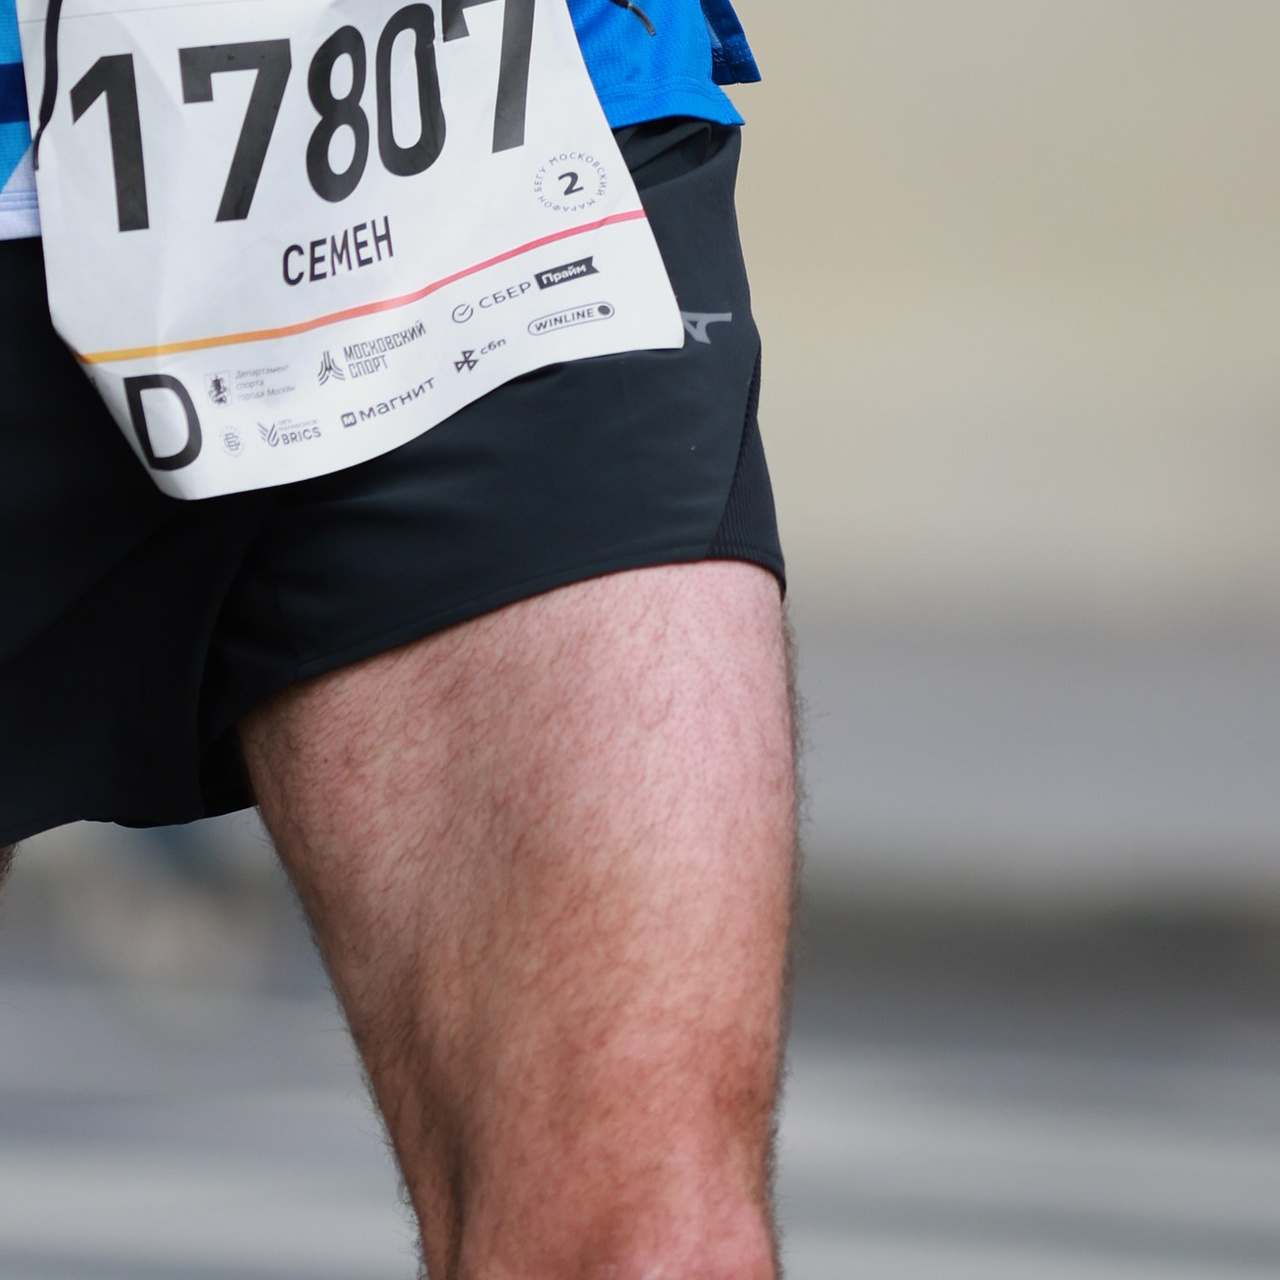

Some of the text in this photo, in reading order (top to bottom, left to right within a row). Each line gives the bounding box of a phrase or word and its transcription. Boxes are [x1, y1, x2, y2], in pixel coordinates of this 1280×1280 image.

[558, 171, 584, 196] 2
[282, 215, 394, 286] СЕМЕН
[479, 263, 588, 309] СБЕР Прайм
[534, 307, 595, 332] WINLINE
[343, 320, 427, 362] МОСКОВСКИЙ
[348, 354, 389, 379] СПОРТ
[122, 375, 202, 472] D
[281, 427, 322, 446] BRICS
